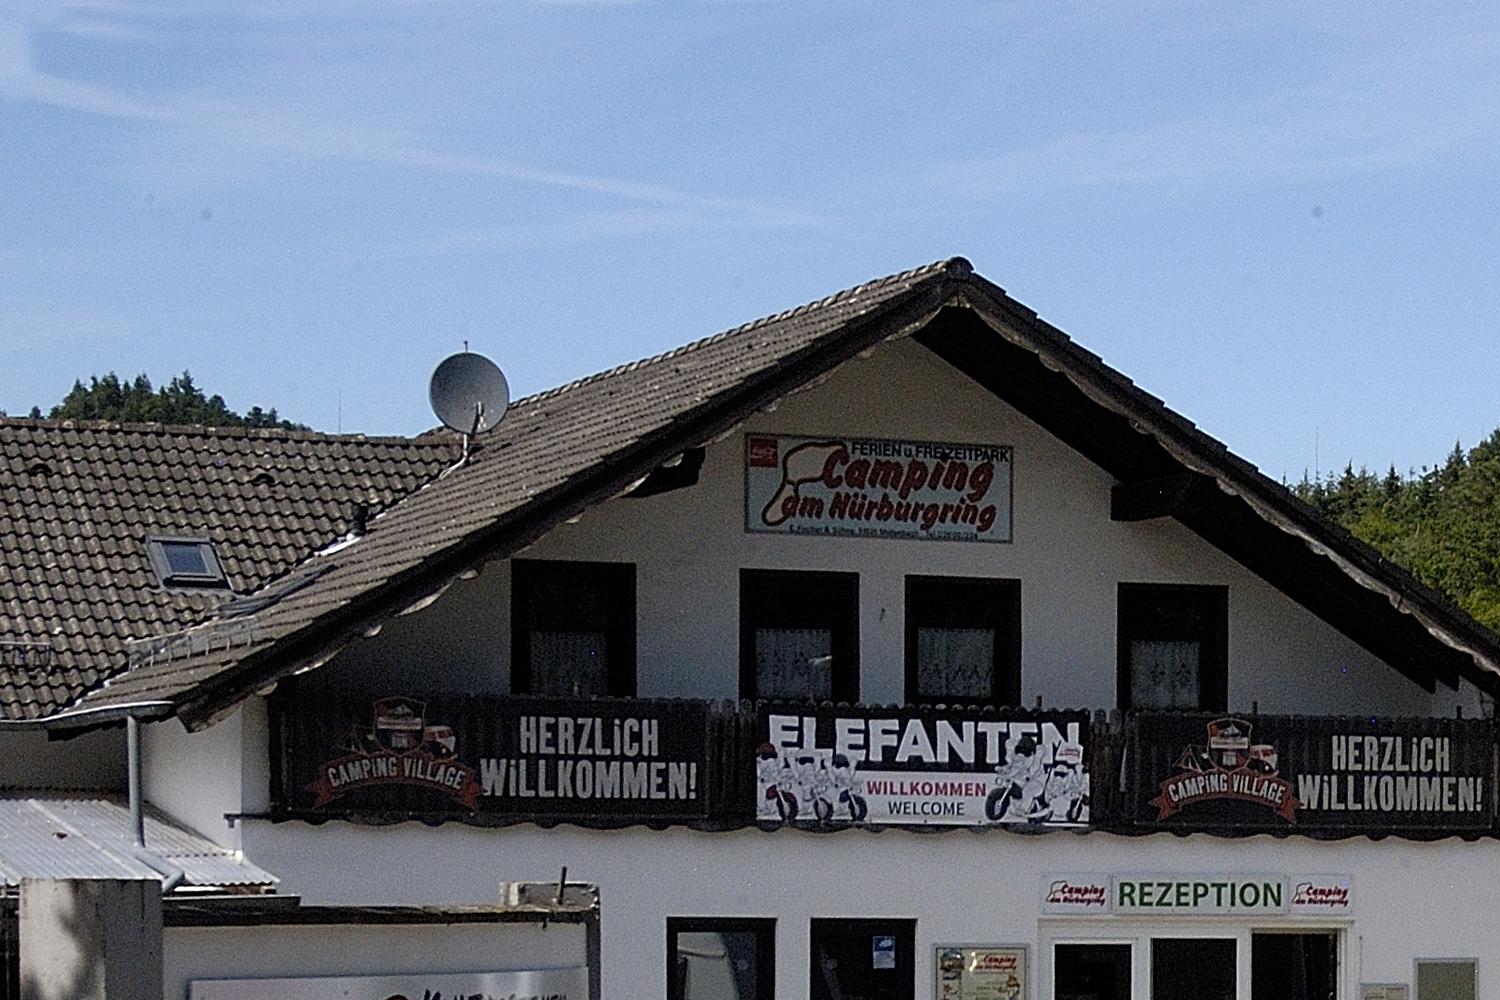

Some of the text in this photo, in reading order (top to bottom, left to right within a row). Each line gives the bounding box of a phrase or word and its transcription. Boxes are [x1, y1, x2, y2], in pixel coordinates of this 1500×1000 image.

[851, 441, 901, 457] FERIEN
[822, 451, 996, 503] Camping
[782, 491, 997, 532] am Nürburgring
[866, 780, 988, 798] WILLKOMMEN
[887, 800, 966, 816] WELCOME
[1061, 884, 1106, 898] Camping
[1118, 881, 1283, 908] REZEPTION
[1306, 886, 1349, 899] Camping
